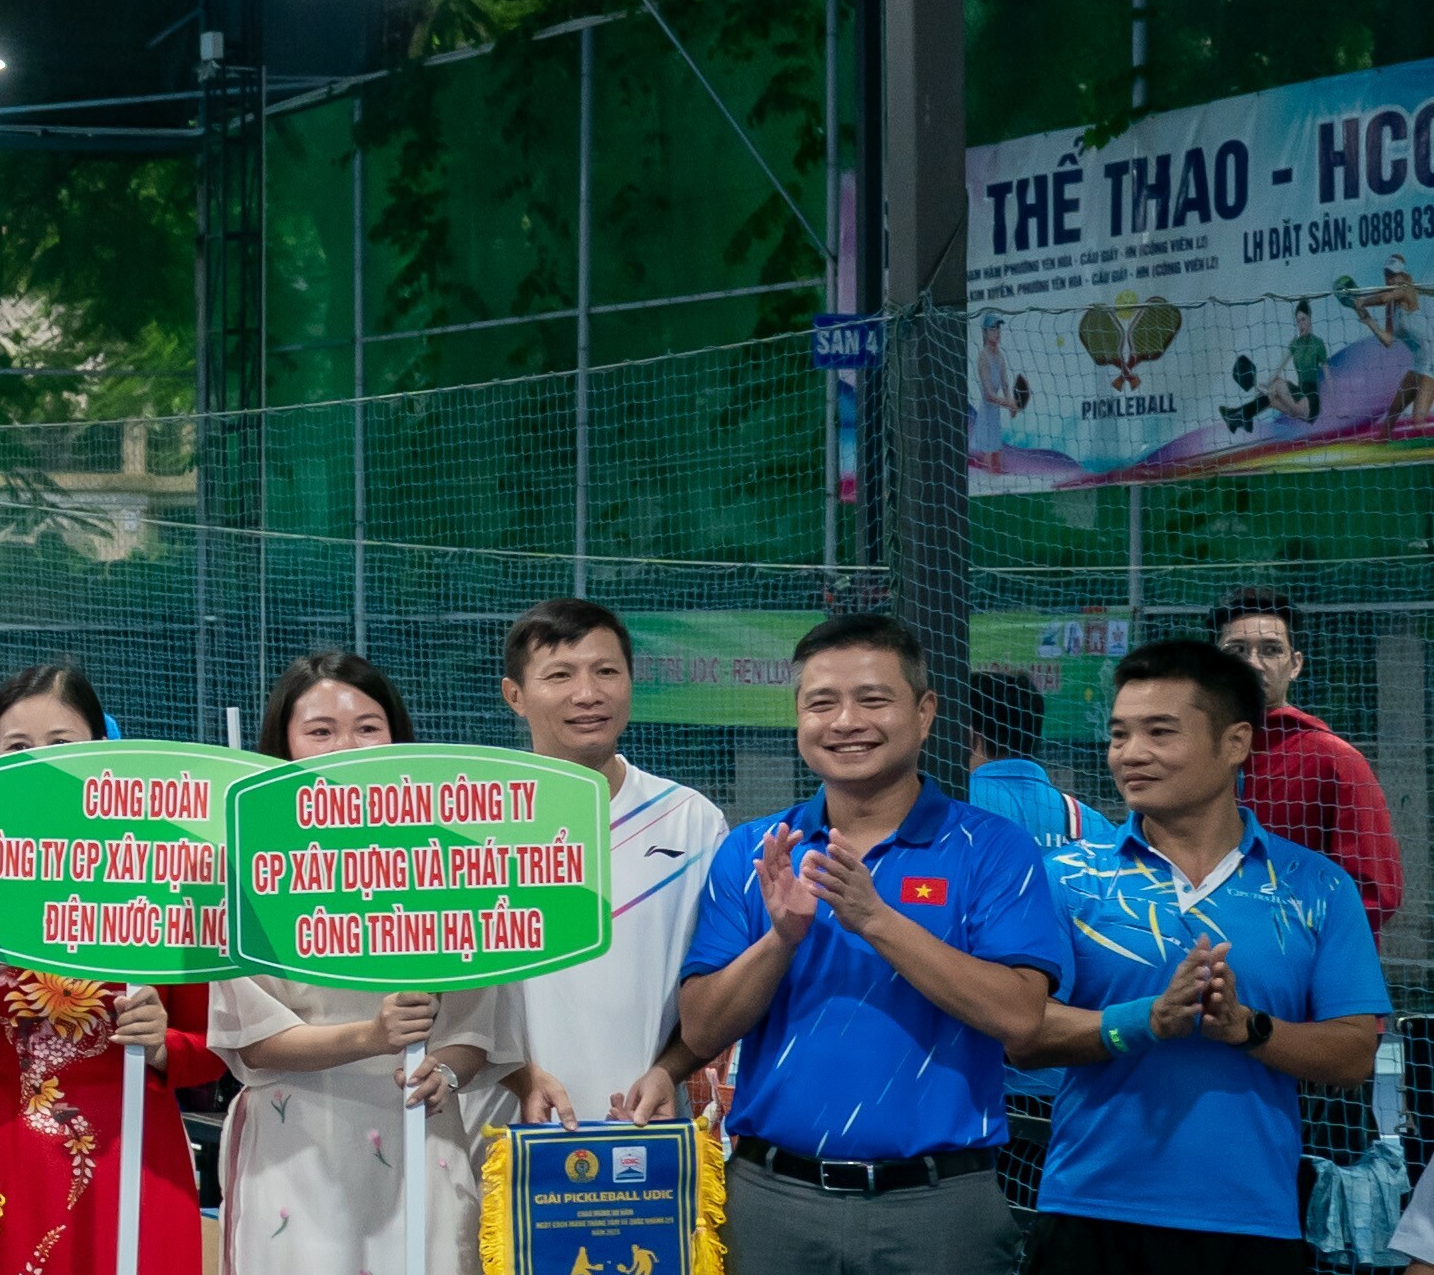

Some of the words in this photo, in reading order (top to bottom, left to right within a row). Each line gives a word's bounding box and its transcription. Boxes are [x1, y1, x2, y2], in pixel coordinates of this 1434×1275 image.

[987, 135, 1084, 255] THỂ
[1104, 139, 1249, 237] THAO
[1243, 229, 1264, 263] LH
[1269, 218, 1302, 266] ĐẶT
[1308, 213, 1352, 254] SÂN:
[1359, 209, 1404, 247] 0888
[865, 330, 878, 355] 4
[1081, 393, 1177, 421] PICKLEBALL
[85, 771, 143, 817] CÔNG
[150, 772, 208, 819] ĐOÀN
[298, 778, 360, 827] CÔNG
[368, 777, 431, 824] ĐOÀN
[439, 775, 502, 823] CÔNG
[509, 781, 536, 821] TY
[41, 840, 66, 879] TY
[71, 841, 99, 880] CP
[106, 834, 148, 881] XÂY
[155, 839, 213, 891] DỰNG
[254, 853, 284, 892] CP
[291, 844, 336, 891] XÂY
[345, 846, 407, 898] DỰNG
[412, 839, 444, 888] VÀ
[452, 838, 509, 887] PHÁT
[515, 829, 583, 885] TRIỂN
[45, 896, 96, 952] ĐIỆN
[102, 897, 159, 944] NƯỚC
[166, 898, 195, 945] HÀ
[297, 907, 360, 955] CÔNG
[367, 905, 436, 953] TRÌNH
[444, 912, 473, 960] HẠ
[481, 897, 542, 950] TẦNG
[535, 1191, 561, 1205] GIẢI
[564, 1191, 640, 1203] PICKLEBALL
[643, 1189, 674, 1199] UDIC
